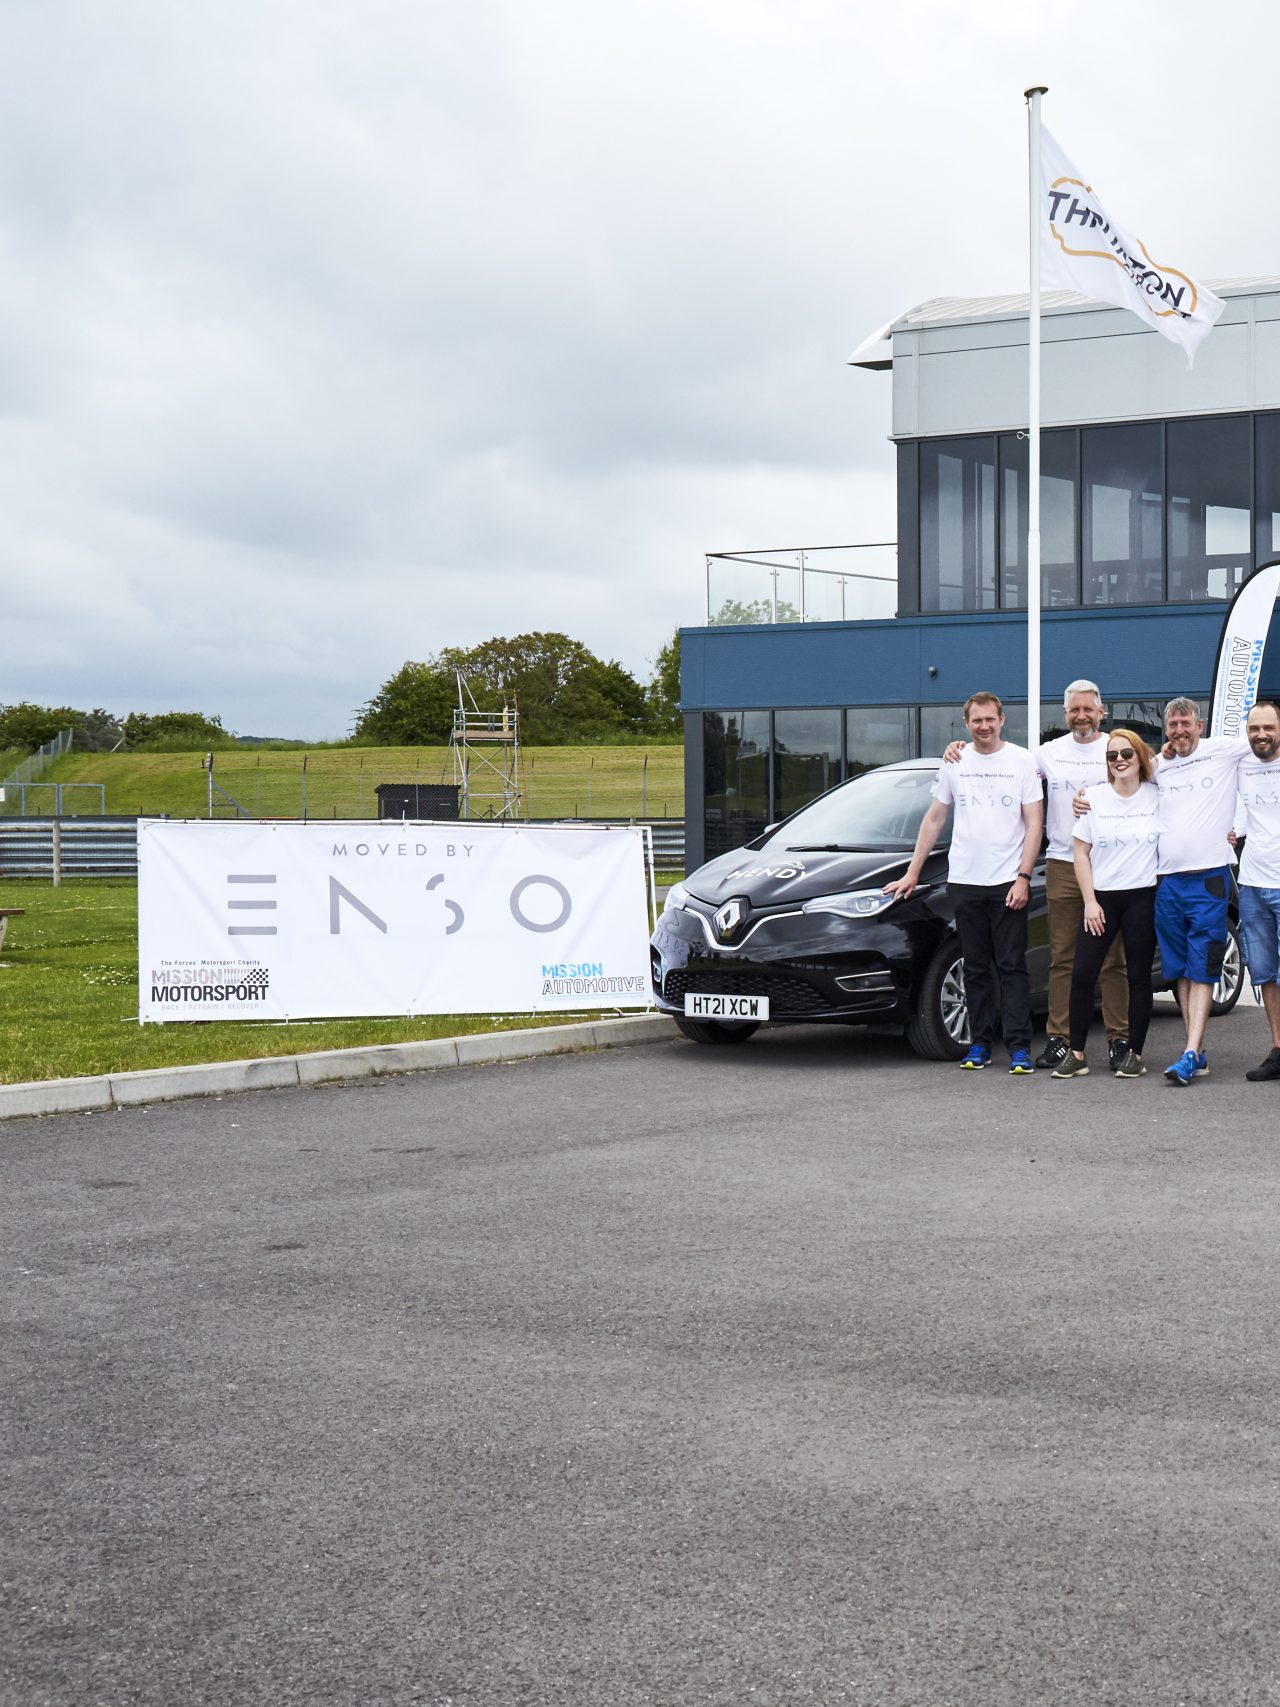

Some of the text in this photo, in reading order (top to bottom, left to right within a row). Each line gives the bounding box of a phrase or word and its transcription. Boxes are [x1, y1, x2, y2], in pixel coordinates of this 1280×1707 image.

[1223, 637, 1252, 739] AUTOMOT
[960, 795, 1013, 807] ENSO
[333, 844, 475, 857] MOVED BY
[725, 867, 814, 882] HENDY
[227, 874, 572, 935] ENSO
[200, 959, 236, 967] Motorsport
[542, 962, 603, 978] MISSION
[151, 968, 223, 985] MISSION
[151, 984, 269, 1002] MOTORSPORT
[542, 976, 645, 995] AUTOMOTIVE
[693, 996, 759, 1017] HT21 XCW
